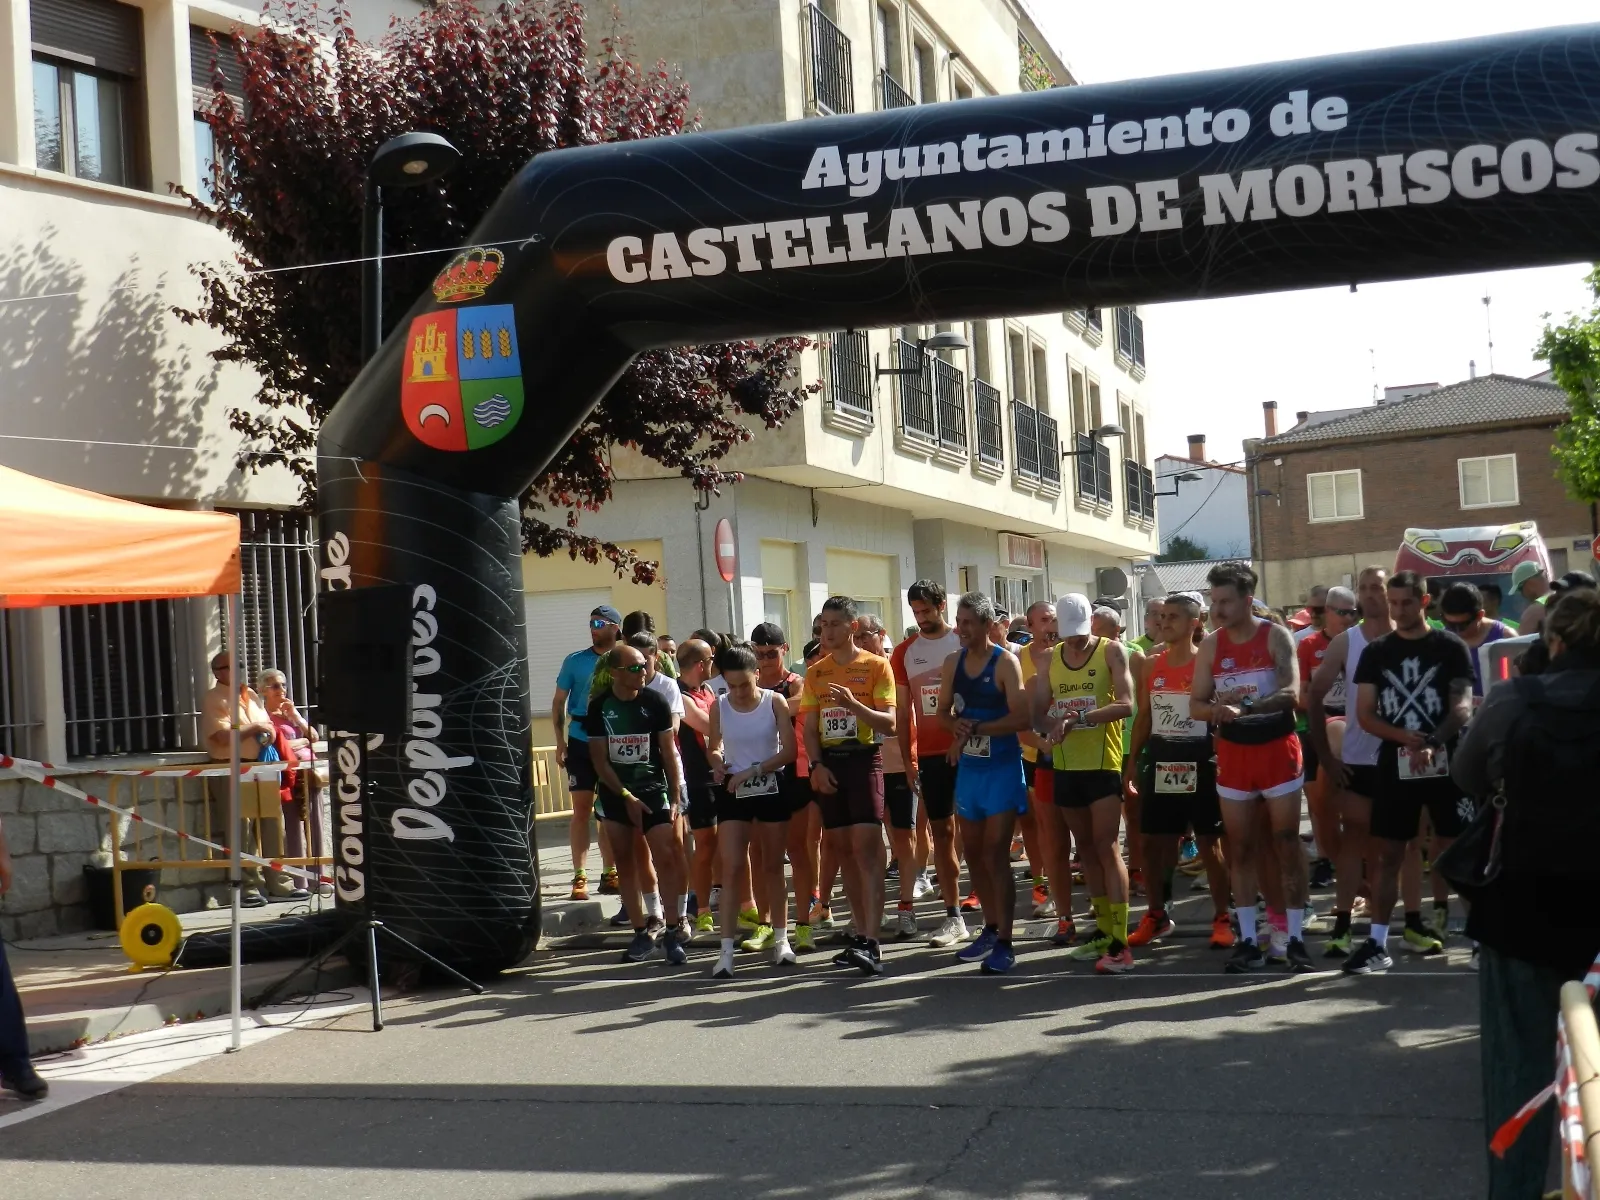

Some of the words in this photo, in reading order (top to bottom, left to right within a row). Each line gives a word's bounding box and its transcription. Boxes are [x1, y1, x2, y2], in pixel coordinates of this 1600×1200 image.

[802, 105, 1250, 197] Ayuntamiento
[1270, 90, 1349, 136] de
[606, 191, 1071, 284] CASTELLANOS
[1090, 178, 1183, 238] DE
[1198, 133, 1600, 226] MORISCOS
[826, 718, 848, 731] 383
[968, 736, 982, 749] 17
[617, 744, 641, 757] 451
[1163, 772, 1189, 786] 414
